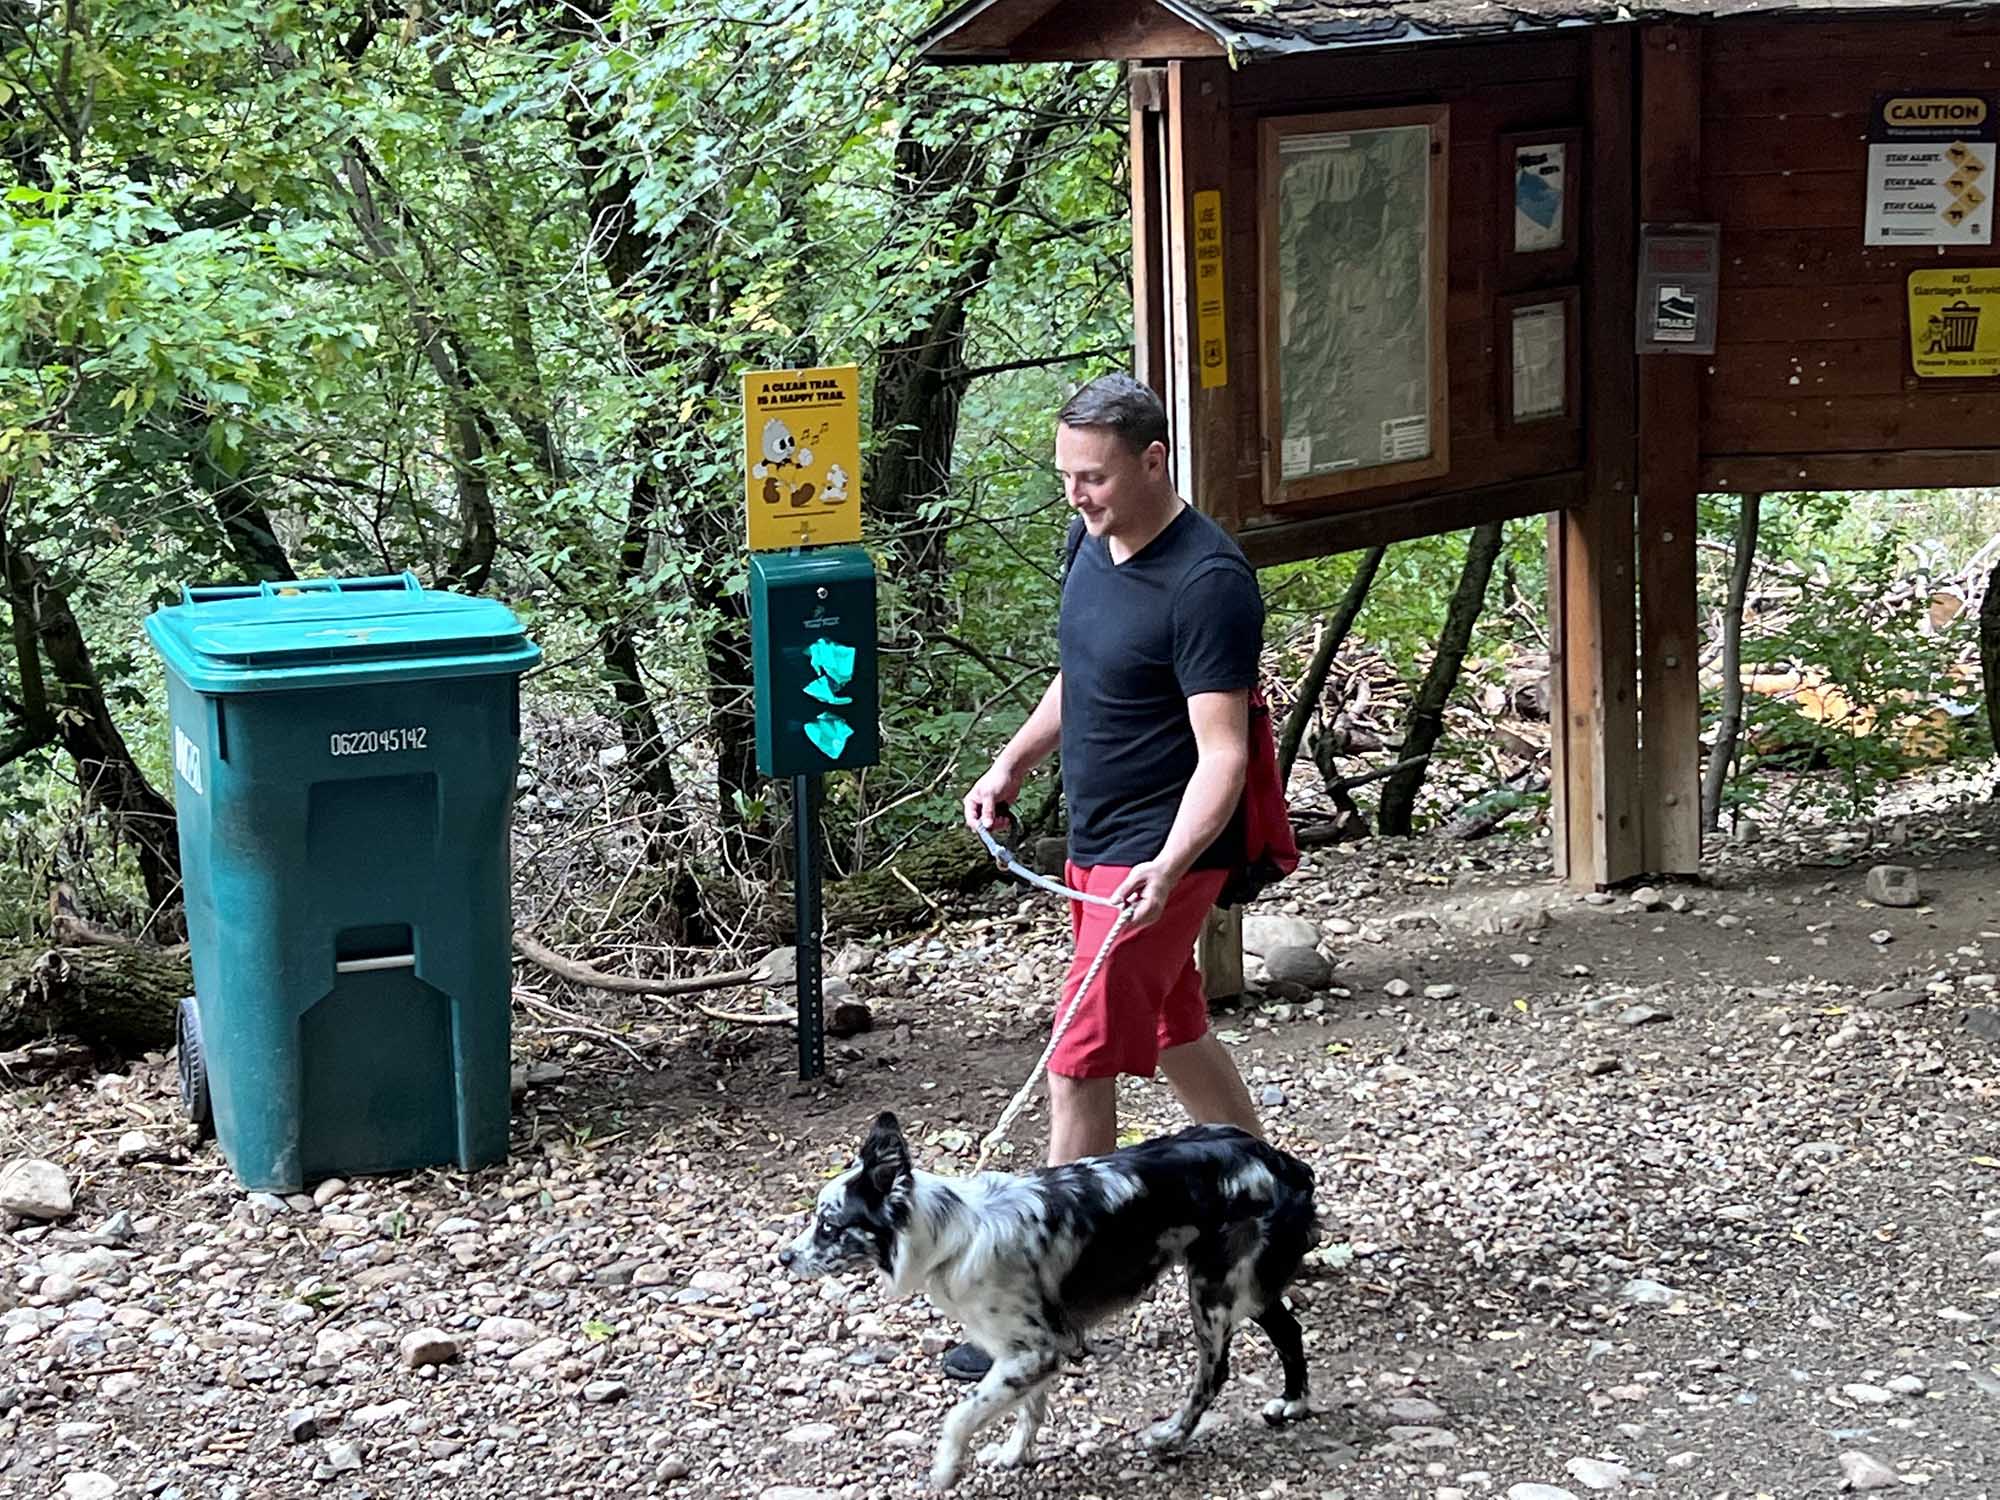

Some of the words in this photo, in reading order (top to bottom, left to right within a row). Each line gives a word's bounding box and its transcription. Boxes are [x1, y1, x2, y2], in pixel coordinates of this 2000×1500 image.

[1891, 105, 1979, 120] CAUTION
[1886, 154, 1909, 162] STAY
[1884, 178, 1906, 186] STAY
[1883, 202, 1905, 210] STAY
[1199, 208, 1216, 222] USE
[1952, 275, 1970, 283] NO
[1914, 286, 1962, 297] Garbage
[1658, 319, 1693, 328] TRAILS
[763, 383, 770, 392] A
[772, 381, 807, 392] CLEAN
[809, 379, 839, 389] TRAIL
[757, 395, 769, 405] IS
[771, 395, 778, 404] A
[780, 393, 814, 403] HAPPY
[816, 391, 846, 401] TRAIL
[331, 727, 427, 756] 0622045142
